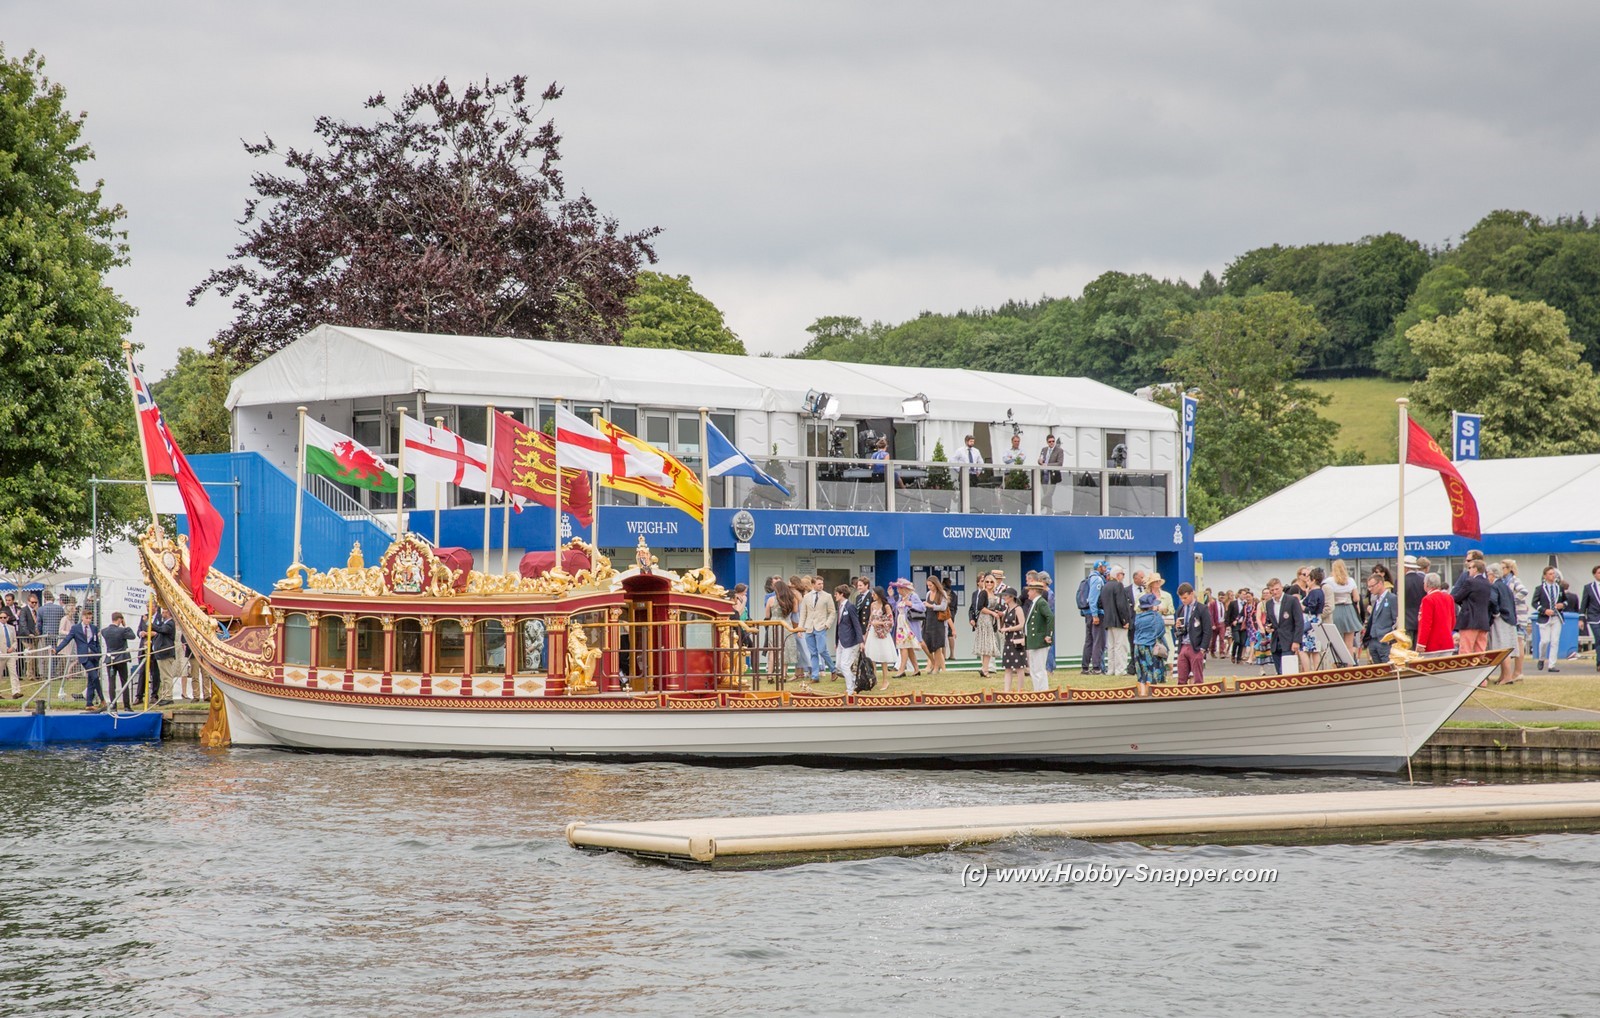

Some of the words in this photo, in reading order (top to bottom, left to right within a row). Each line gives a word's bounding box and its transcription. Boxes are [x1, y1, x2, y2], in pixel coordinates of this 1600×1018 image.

[626, 521, 678, 534] WEIGH-IN
[774, 523, 800, 536] BOAT
[800, 524, 827, 536] TENT
[827, 524, 870, 537] OFFICIAL
[1098, 528, 1135, 540] MEDICAL
[974, 527, 1012, 542] ENQUIRY
[1341, 542, 1382, 552] OFFICIAL
[1426, 540, 1451, 550] SHOP
